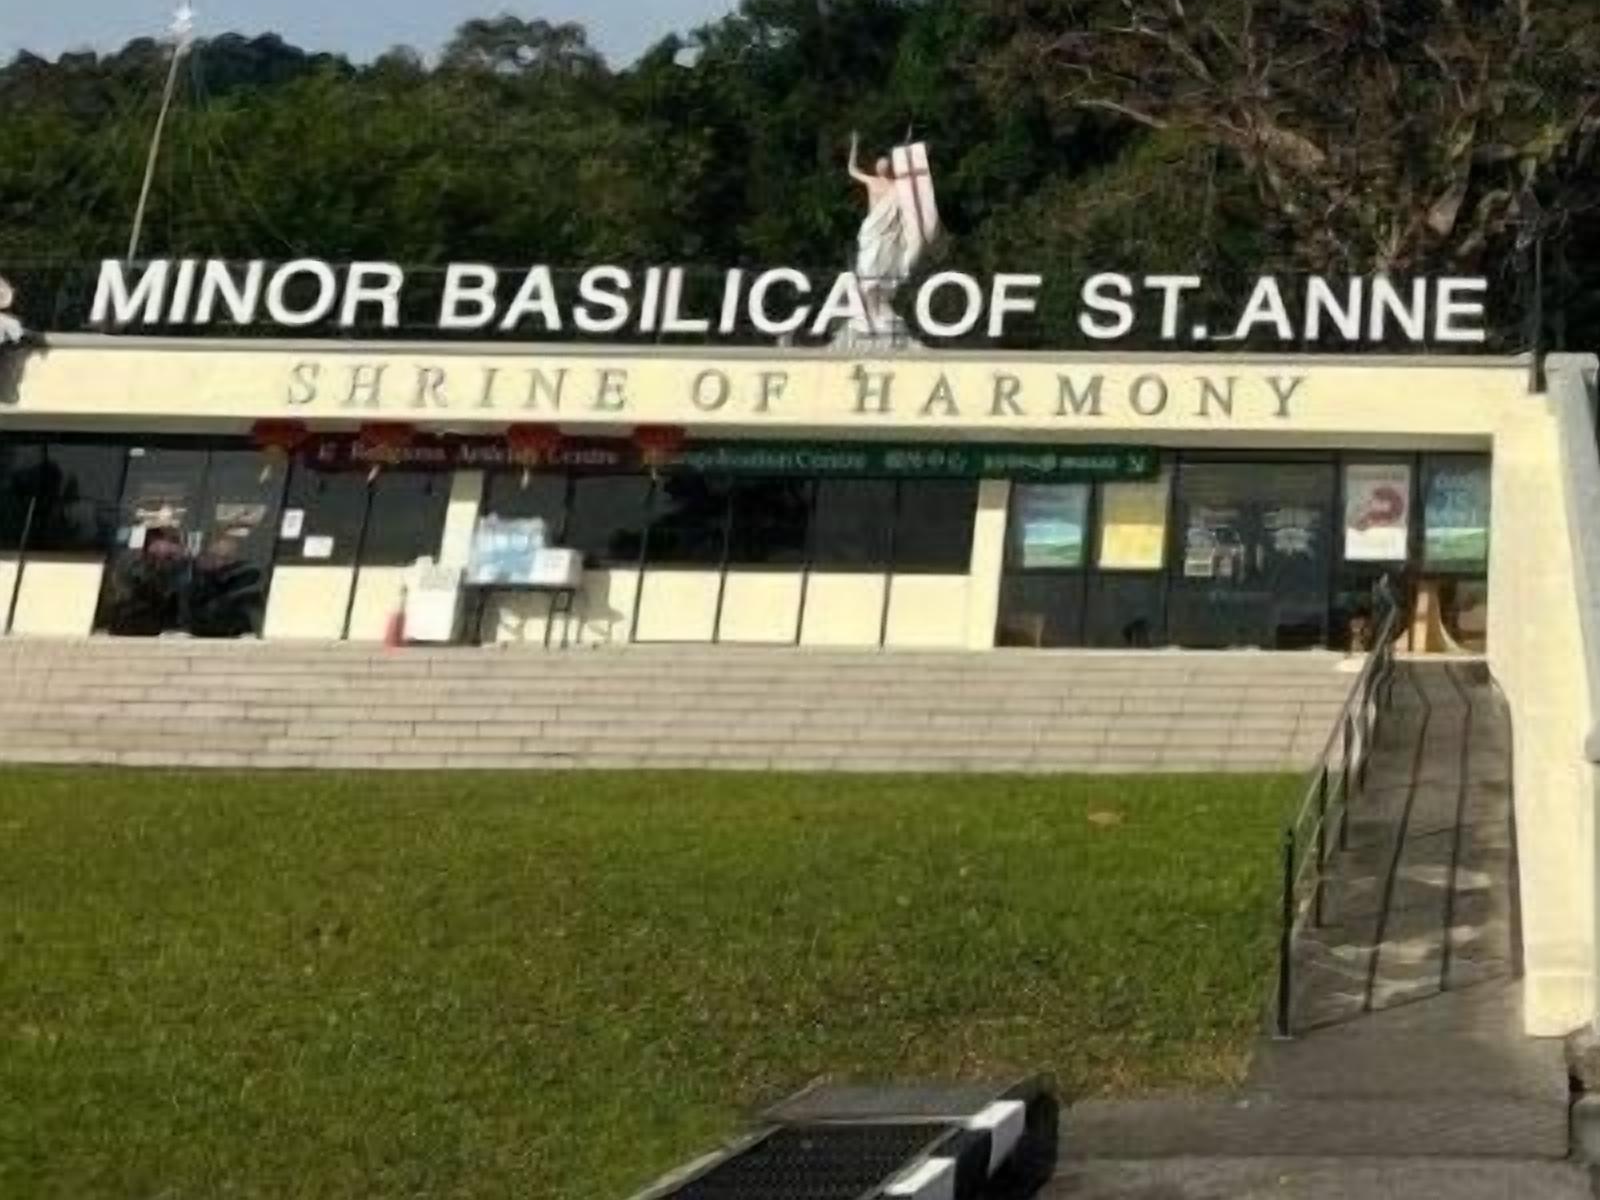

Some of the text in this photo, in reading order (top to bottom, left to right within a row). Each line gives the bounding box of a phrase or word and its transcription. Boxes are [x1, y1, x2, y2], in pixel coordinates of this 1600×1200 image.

[90, 259, 1488, 341] MINOR BASILICA OF ST. ANNE
[287, 362, 1308, 418] SHRINE OF HARMONY
